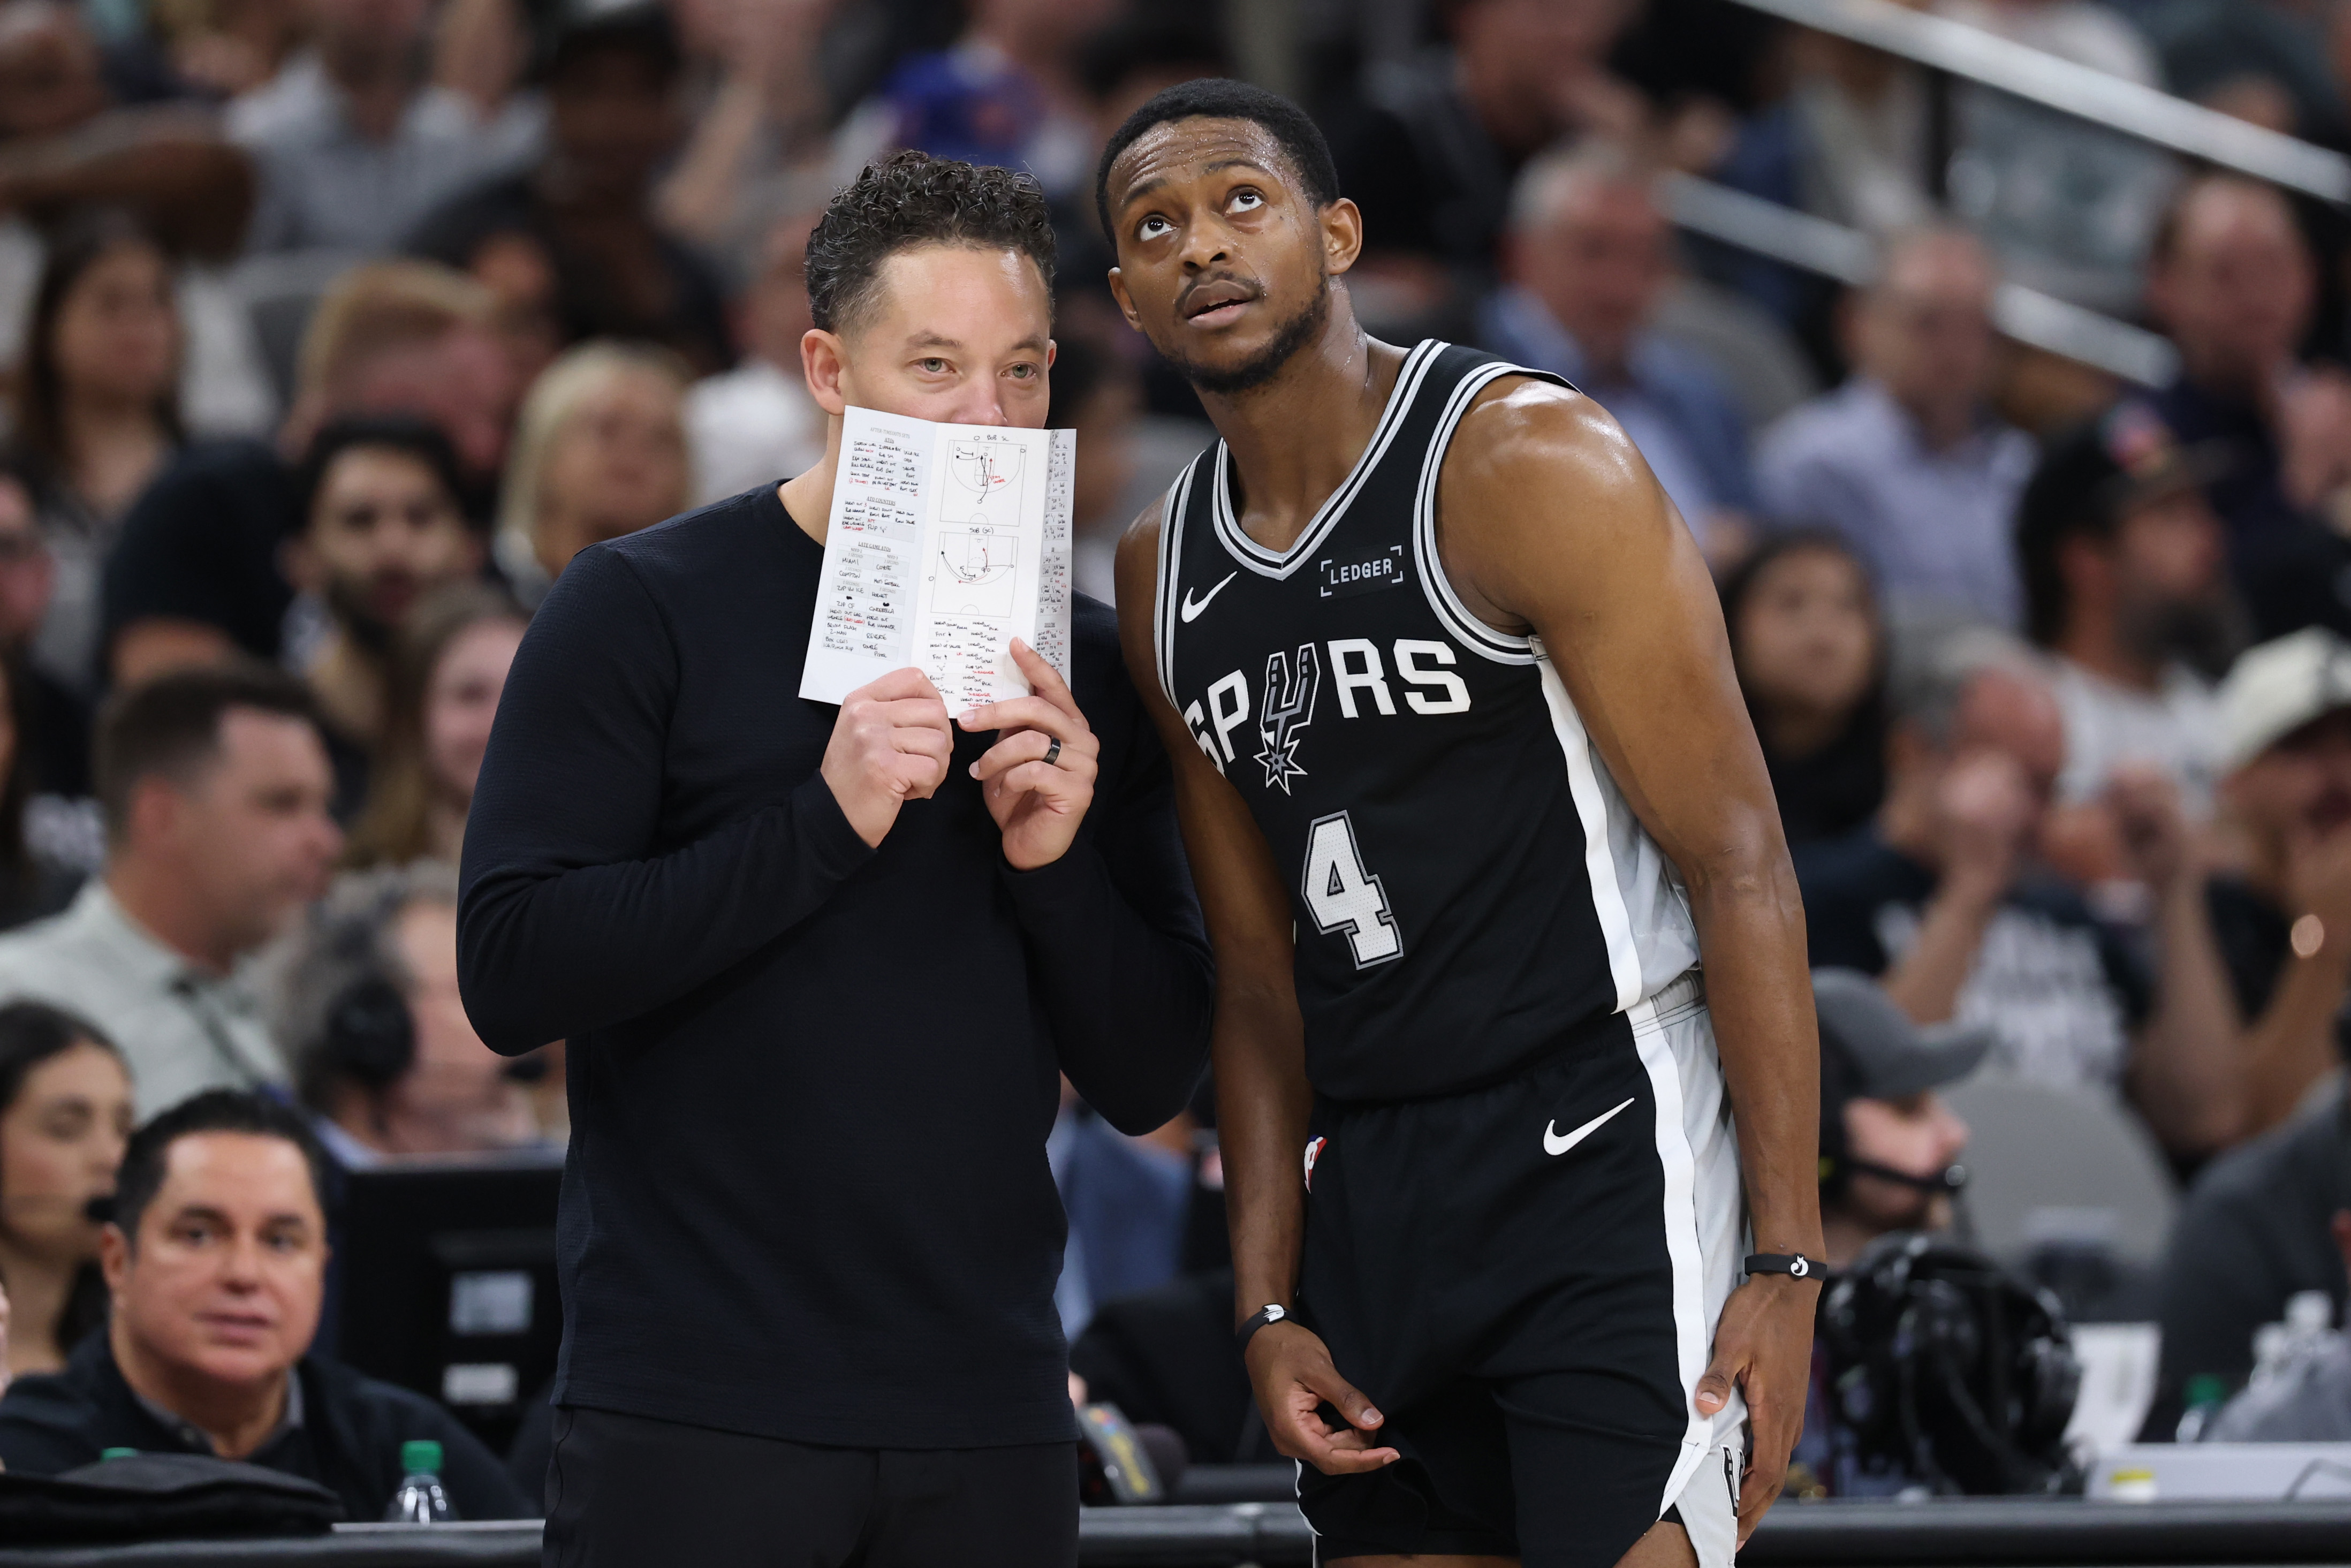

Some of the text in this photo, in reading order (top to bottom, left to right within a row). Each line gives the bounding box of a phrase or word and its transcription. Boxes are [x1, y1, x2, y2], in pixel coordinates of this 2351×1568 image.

[876, 497, 896, 506] COUNTERS
[842, 557, 859, 565] MIAMI
[839, 570, 861, 578] COMPTON
[1330, 558, 1392, 585] LEDGER
[1183, 638, 1472, 796] SPURS
[1301, 809, 1404, 971] 4
